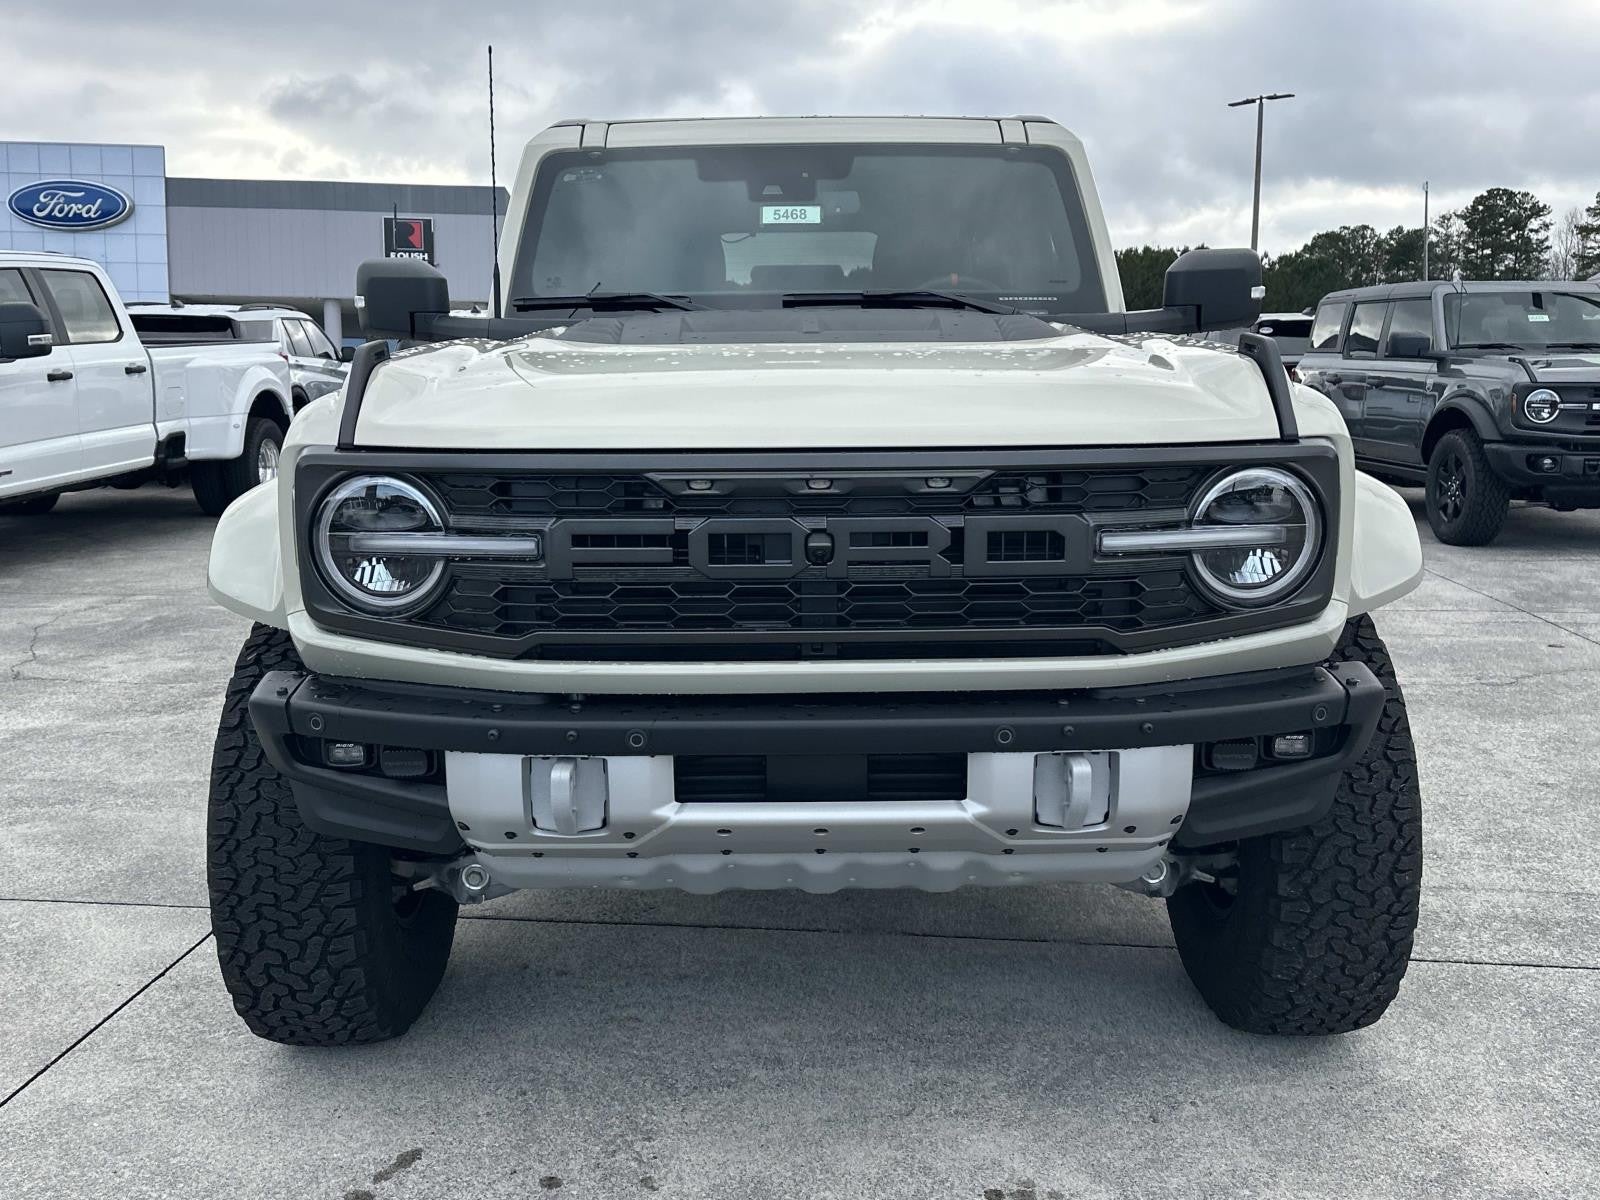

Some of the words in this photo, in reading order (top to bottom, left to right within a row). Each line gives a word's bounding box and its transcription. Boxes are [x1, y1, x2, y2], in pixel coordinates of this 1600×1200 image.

[32, 189, 104, 218] Ford
[773, 208, 807, 221] 5468
[546, 514, 1091, 580] FORD
